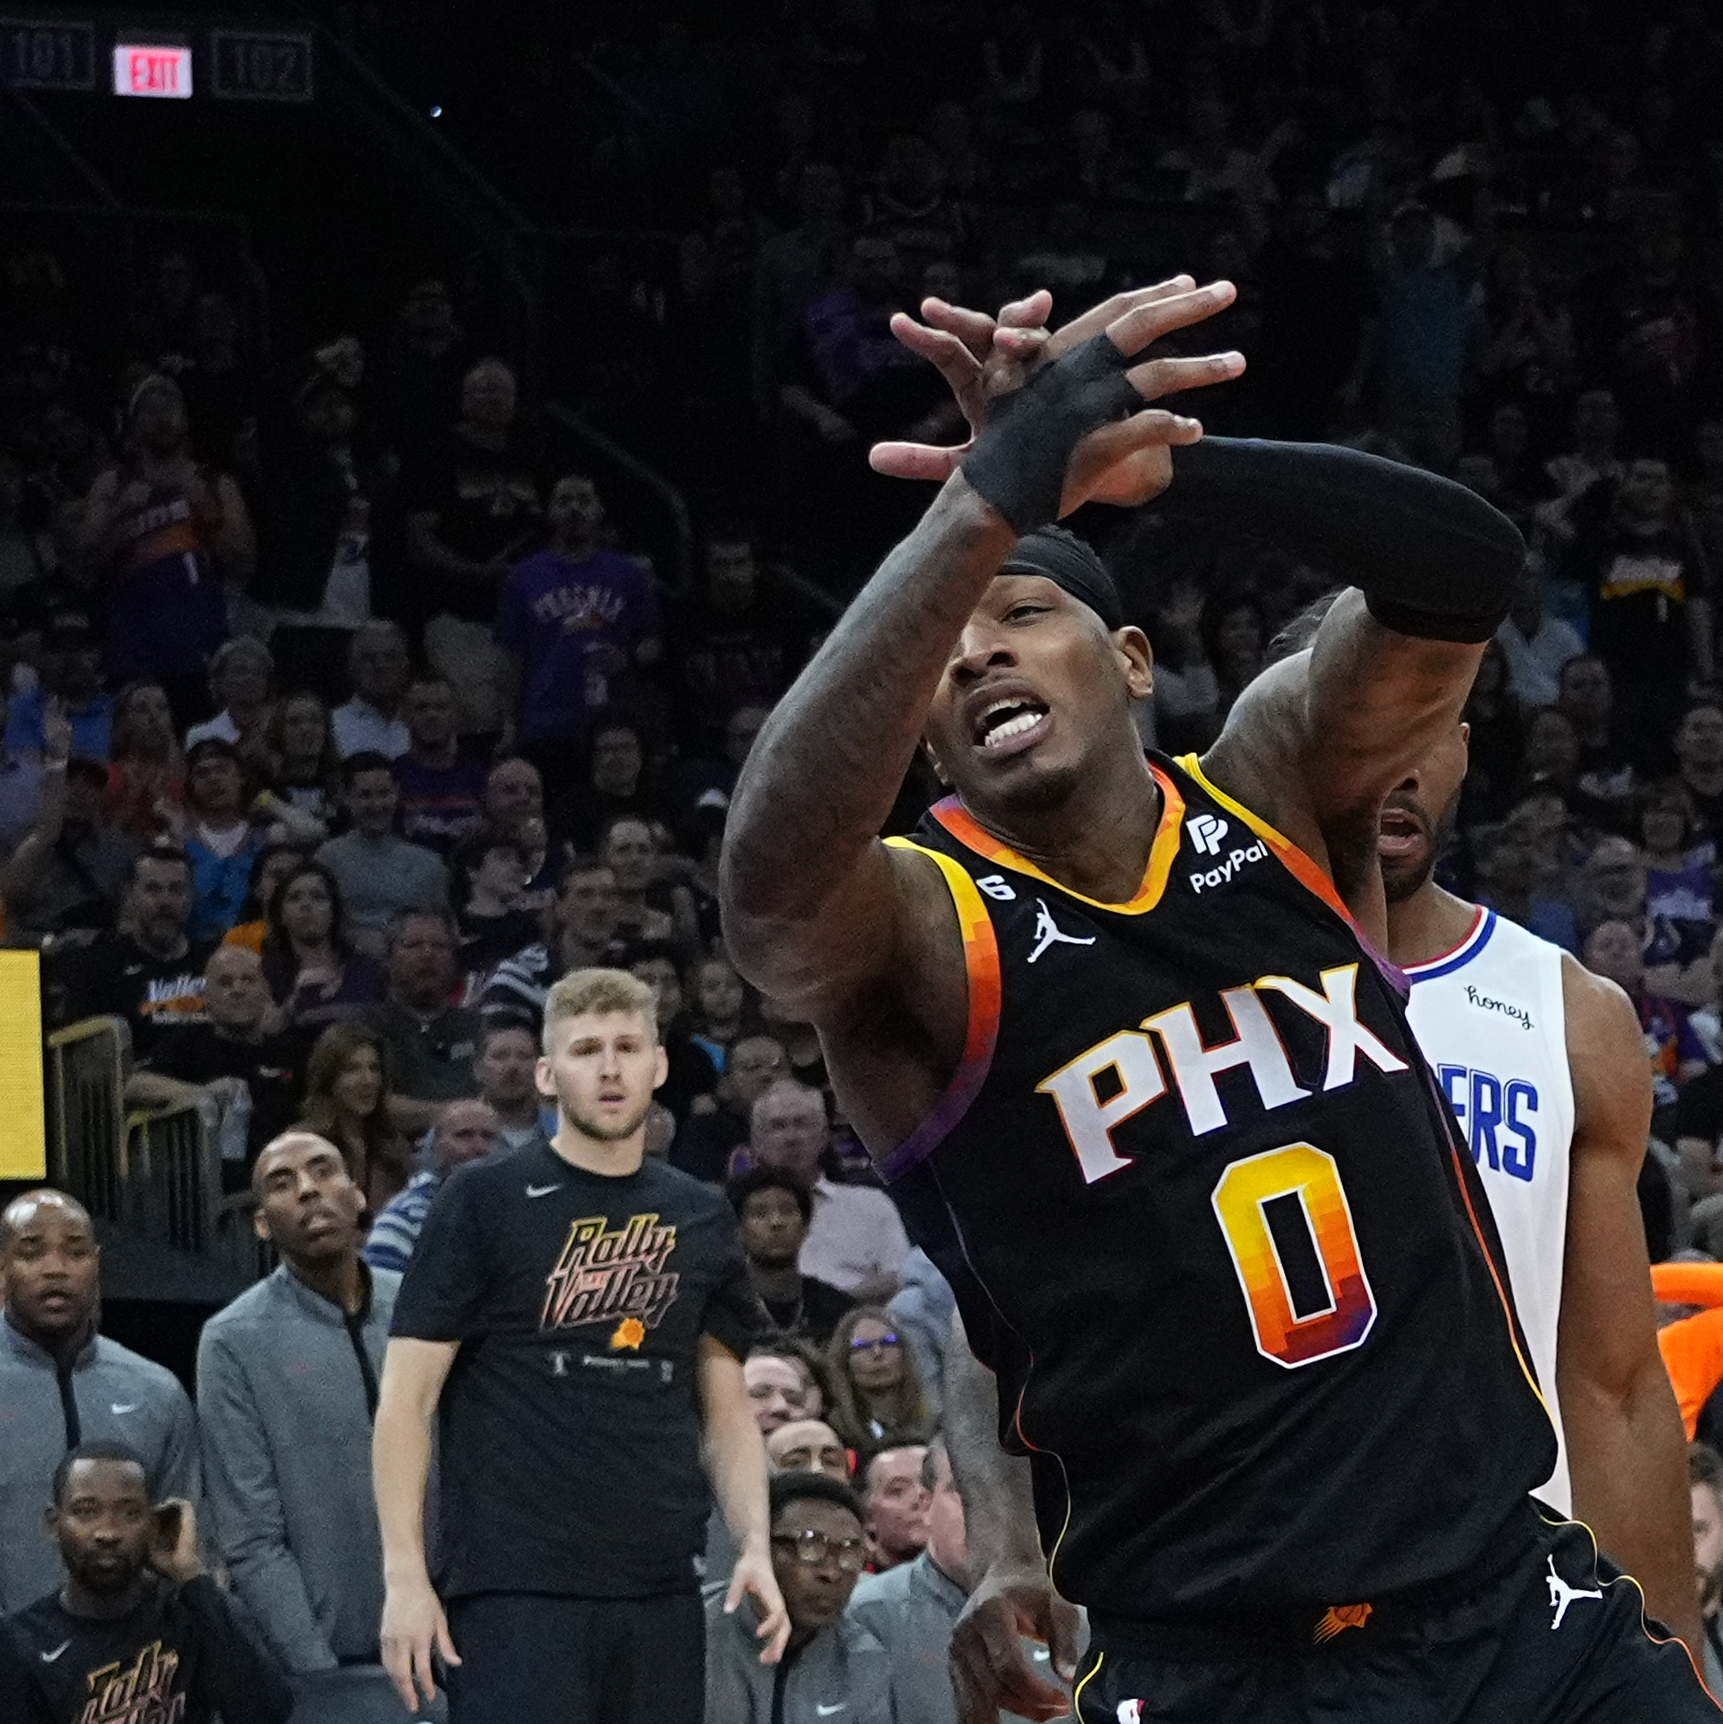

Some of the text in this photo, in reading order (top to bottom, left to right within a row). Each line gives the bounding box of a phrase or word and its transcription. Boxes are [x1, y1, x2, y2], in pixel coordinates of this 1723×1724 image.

[130, 53, 182, 92] EXIT
[976, 874, 1017, 901] 6
[1189, 839, 1269, 894] PayPal
[1464, 985, 1535, 1030] honey
[1034, 963, 1409, 1185] PHX
[1210, 1141, 1378, 1369] 0
